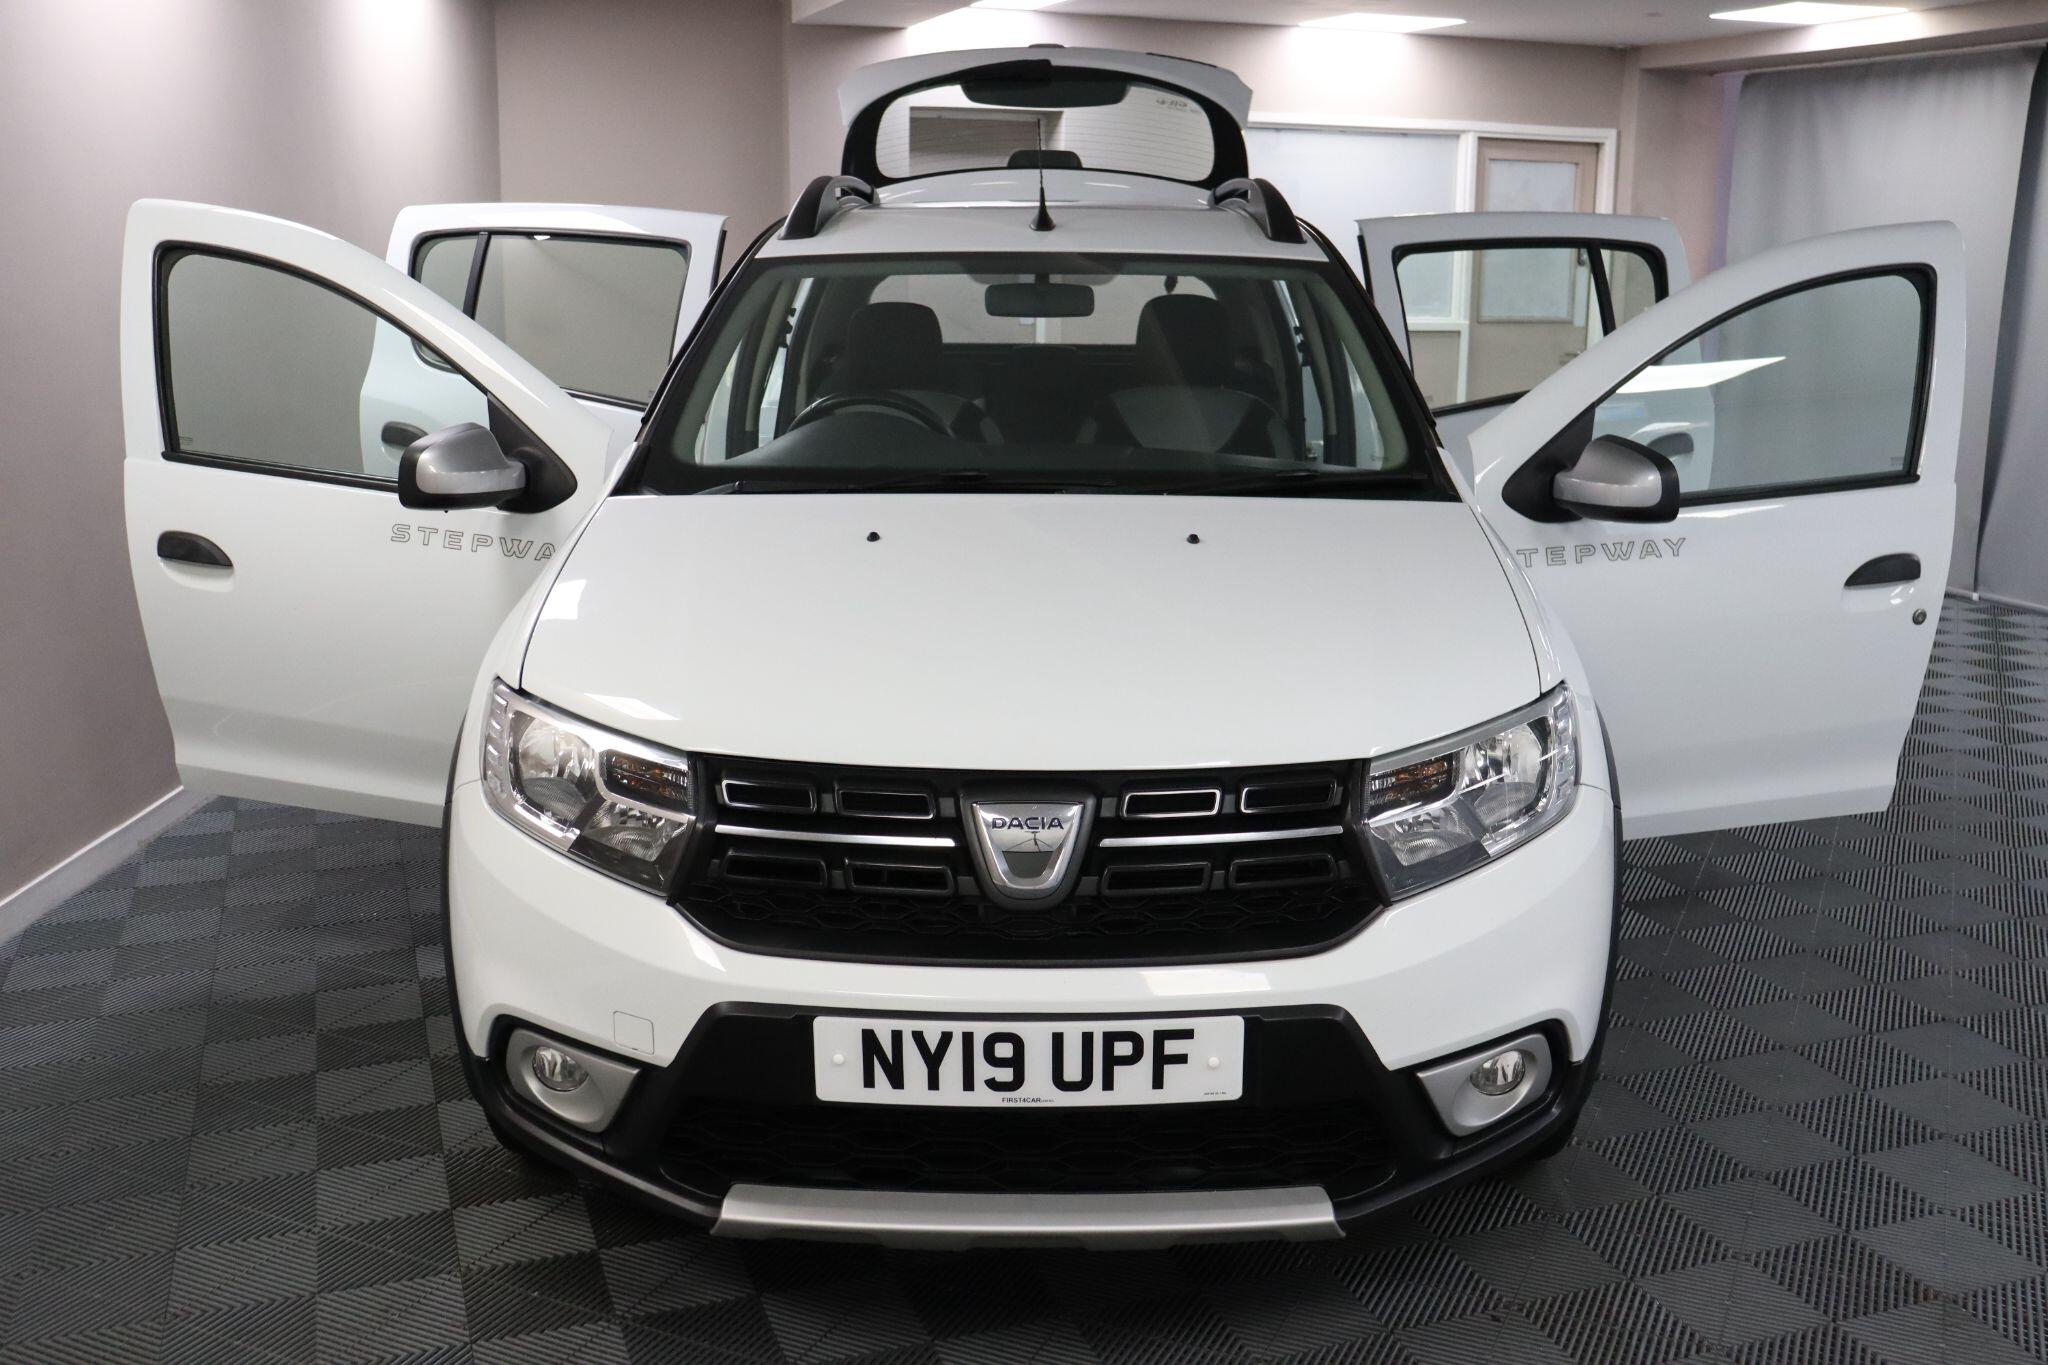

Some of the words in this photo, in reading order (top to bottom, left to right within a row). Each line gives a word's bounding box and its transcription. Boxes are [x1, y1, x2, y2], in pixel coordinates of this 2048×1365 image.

[1516, 537, 1686, 568] TEPWAY
[991, 816, 1065, 830] DACIA
[860, 1028, 1025, 1092] NY19
[1051, 1028, 1195, 1092] UPF
